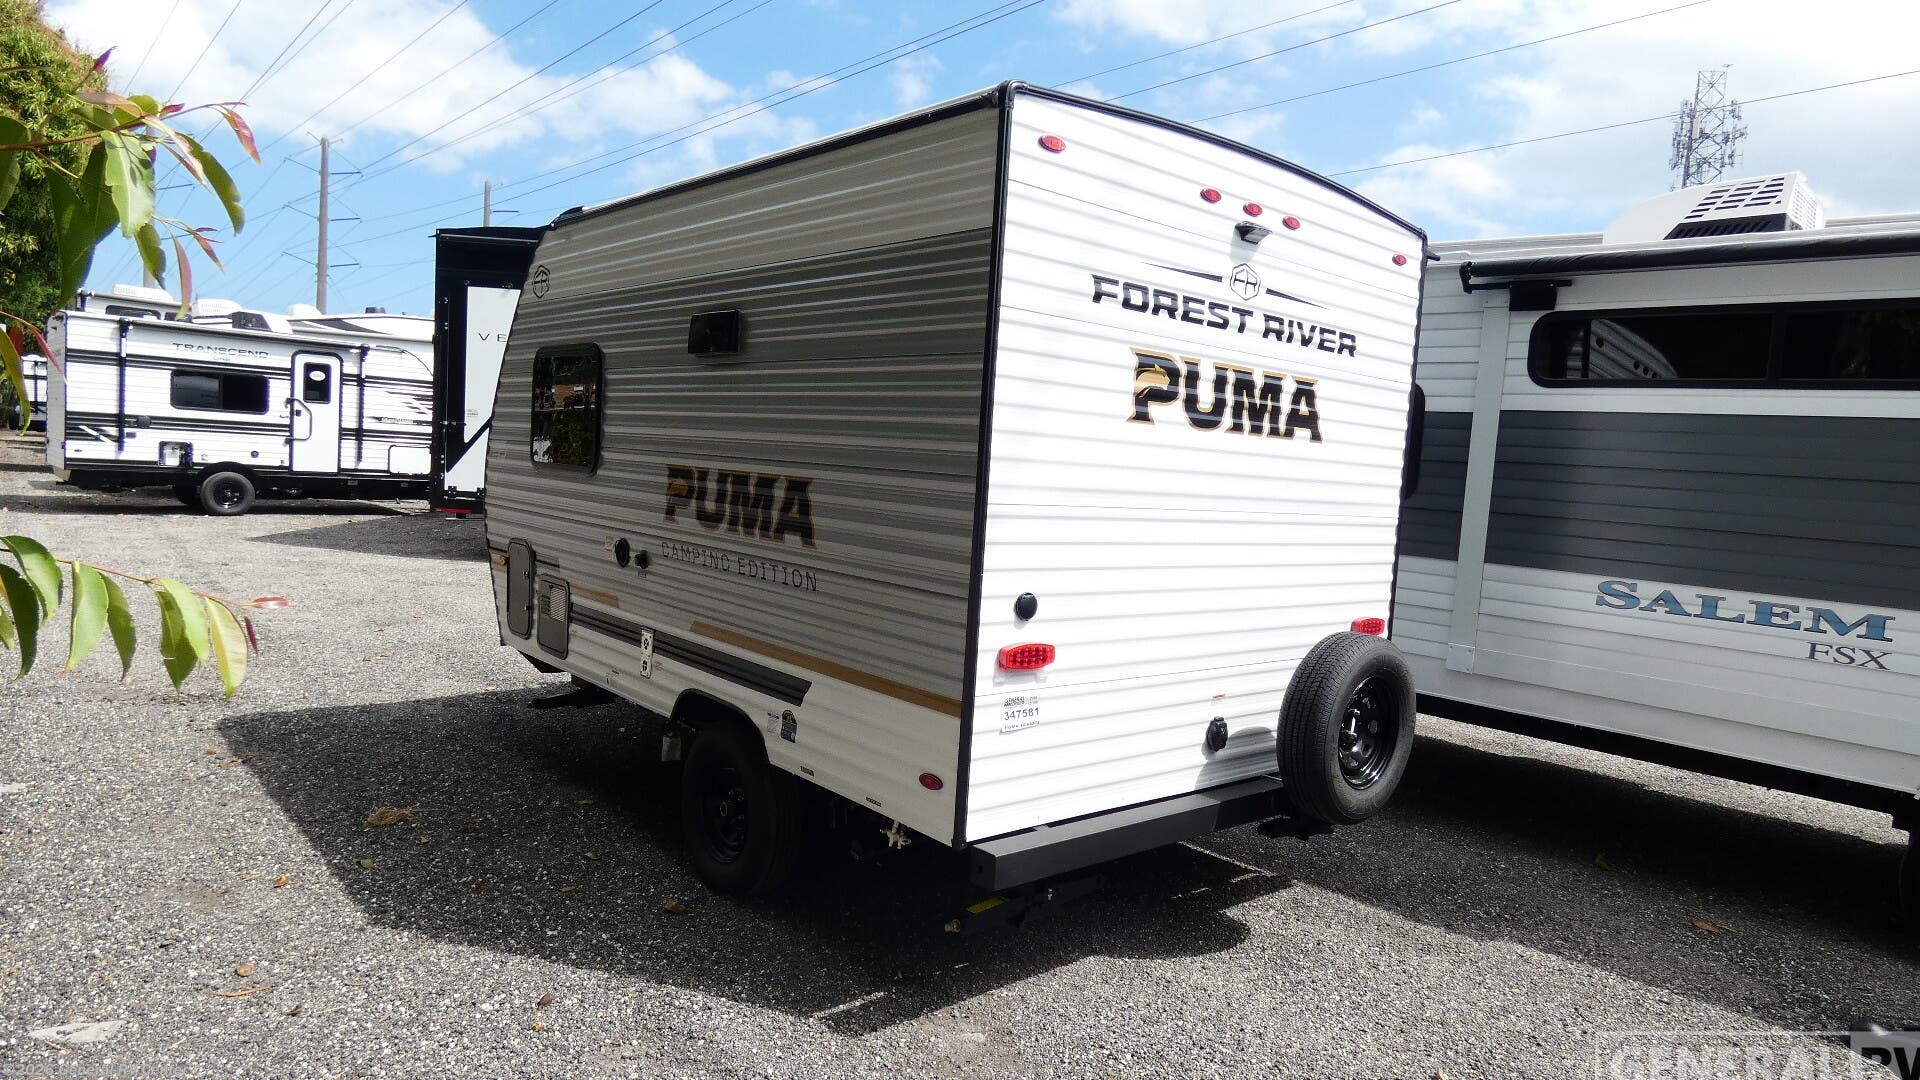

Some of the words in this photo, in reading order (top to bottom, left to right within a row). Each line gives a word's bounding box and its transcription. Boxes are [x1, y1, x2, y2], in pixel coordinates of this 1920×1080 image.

[1091, 274, 1253, 333] FOREST
[1262, 313, 1357, 357] RIVER
[172, 342, 269, 358] TRANSCEND
[1126, 347, 1322, 444] PUMA
[663, 464, 817, 549] PUMA
[661, 541, 730, 572] CAMPING
[738, 557, 817, 591] EDITION
[1596, 580, 1896, 642] SALEM
[1806, 641, 1893, 671] FSX
